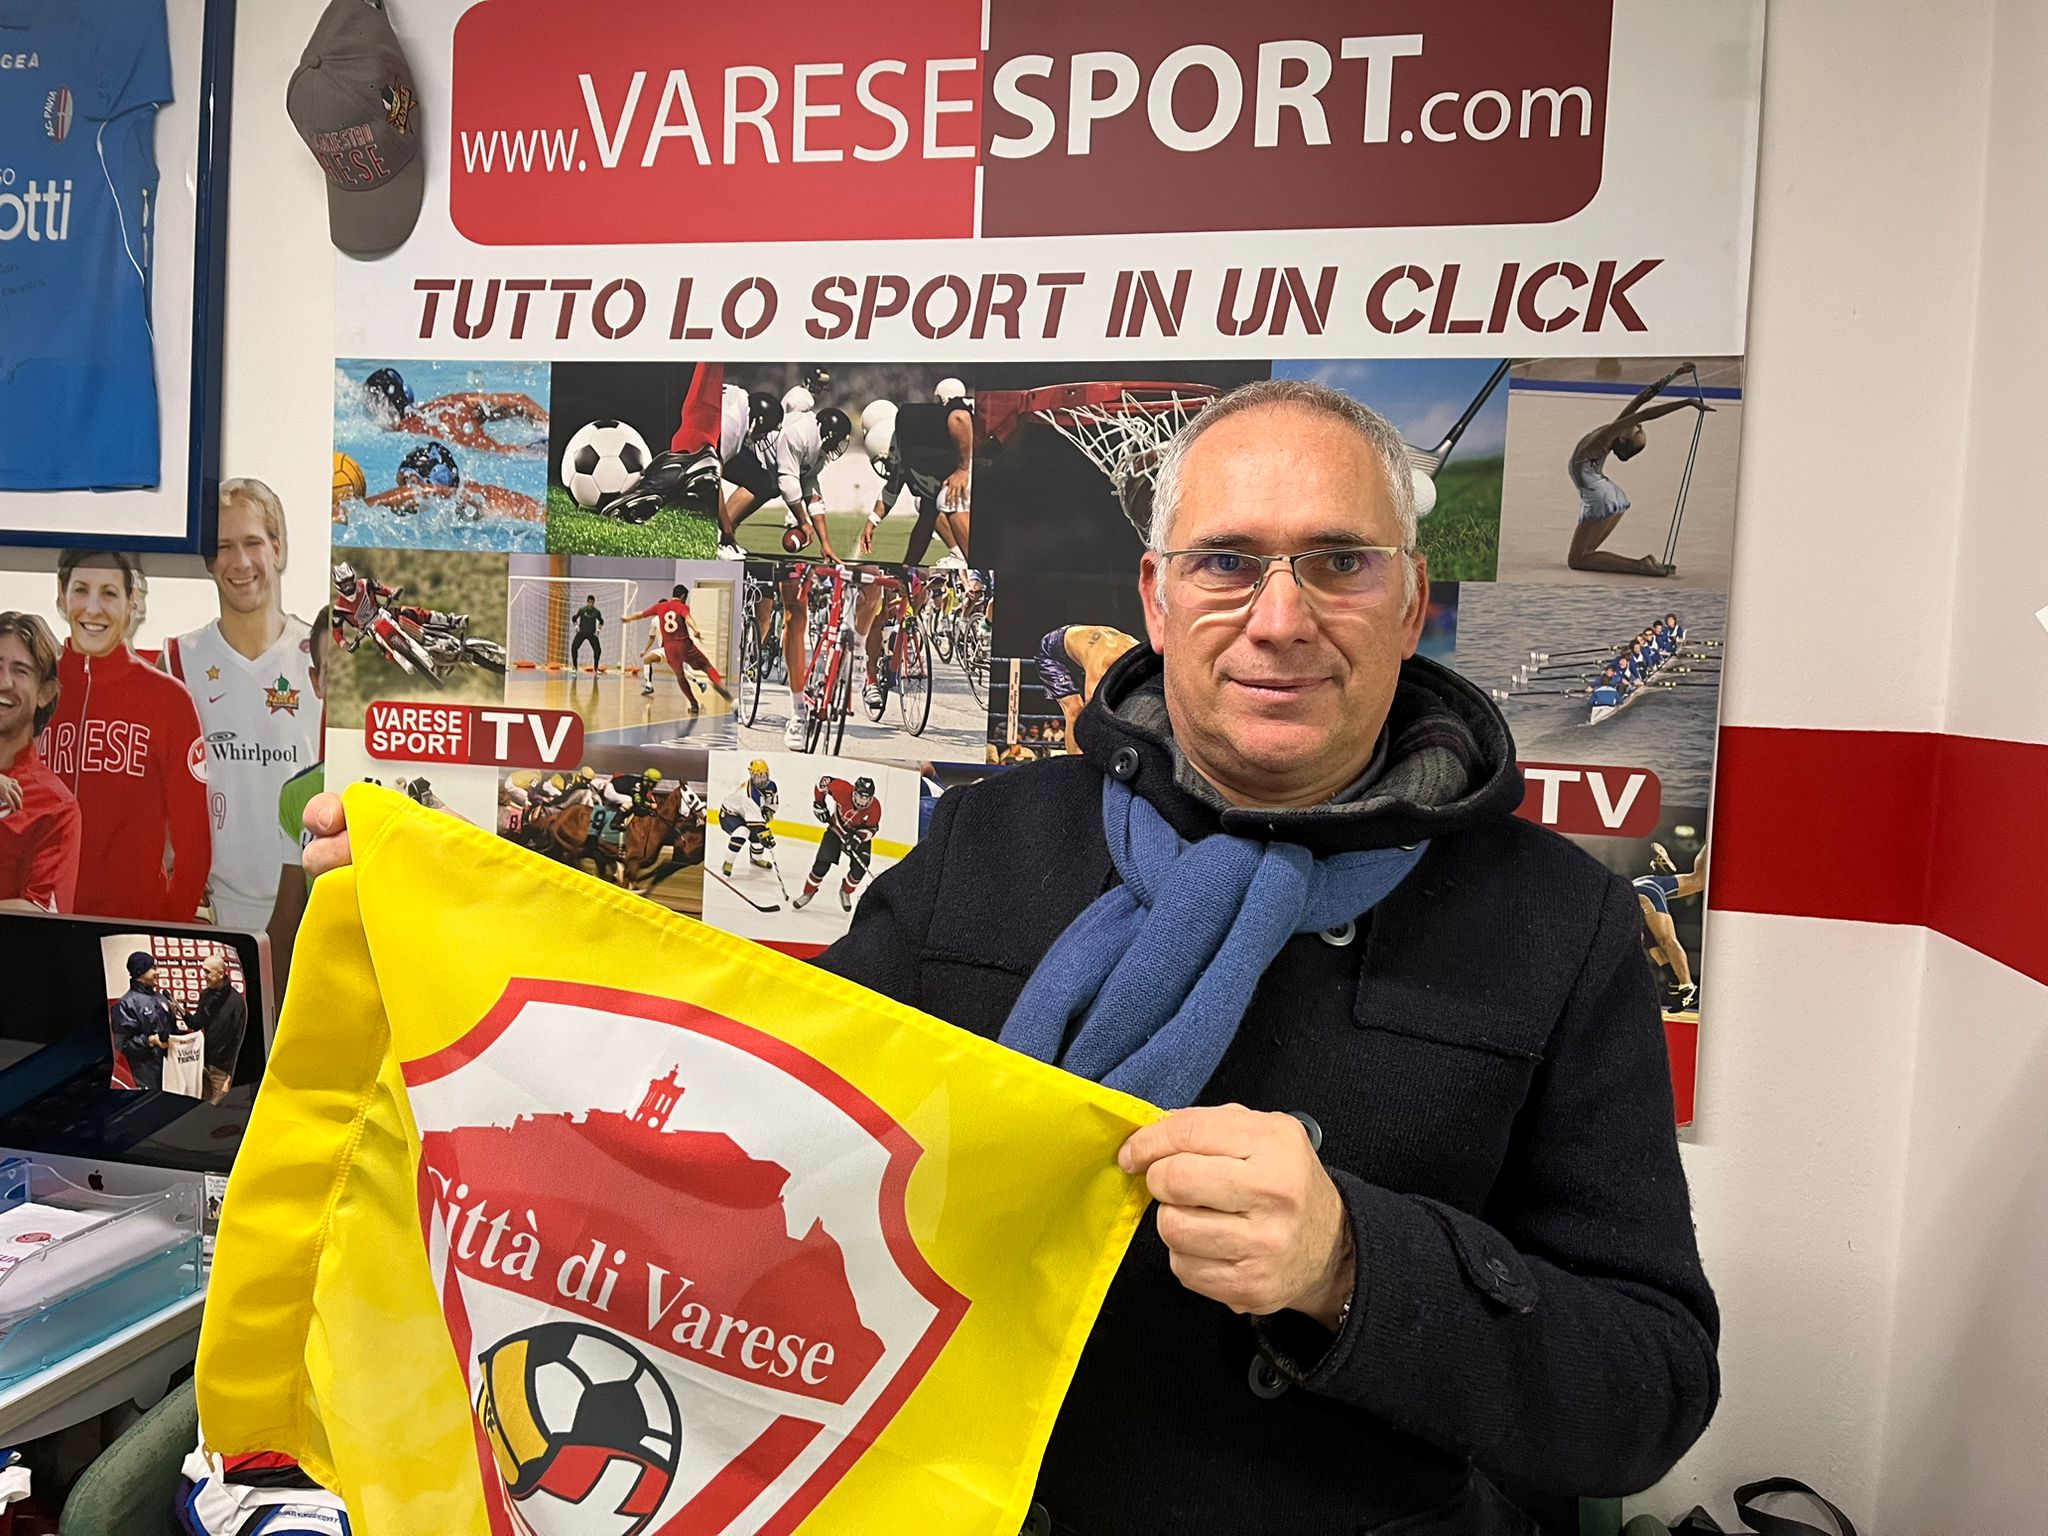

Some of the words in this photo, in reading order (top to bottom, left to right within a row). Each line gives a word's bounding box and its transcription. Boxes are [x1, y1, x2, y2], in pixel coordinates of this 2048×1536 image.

[460, 33, 1593, 174] www.VARESESPORT.com
[413, 277, 647, 340] TUTTO
[669, 276, 779, 340] LO
[804, 271, 1086, 341] SPORT
[1104, 269, 1193, 339] IN
[1215, 266, 1339, 336] UN
[1364, 258, 1666, 335] CLICK
[663, 610, 679, 633] 8
[210, 742, 298, 767] Whirlpool
[371, 706, 463, 734] VARESE
[480, 711, 574, 764] TV
[371, 730, 463, 756] SPORT
[1523, 767, 1647, 829] TV
[556, 1238, 628, 1313] di
[645, 1261, 835, 1385] Varese
